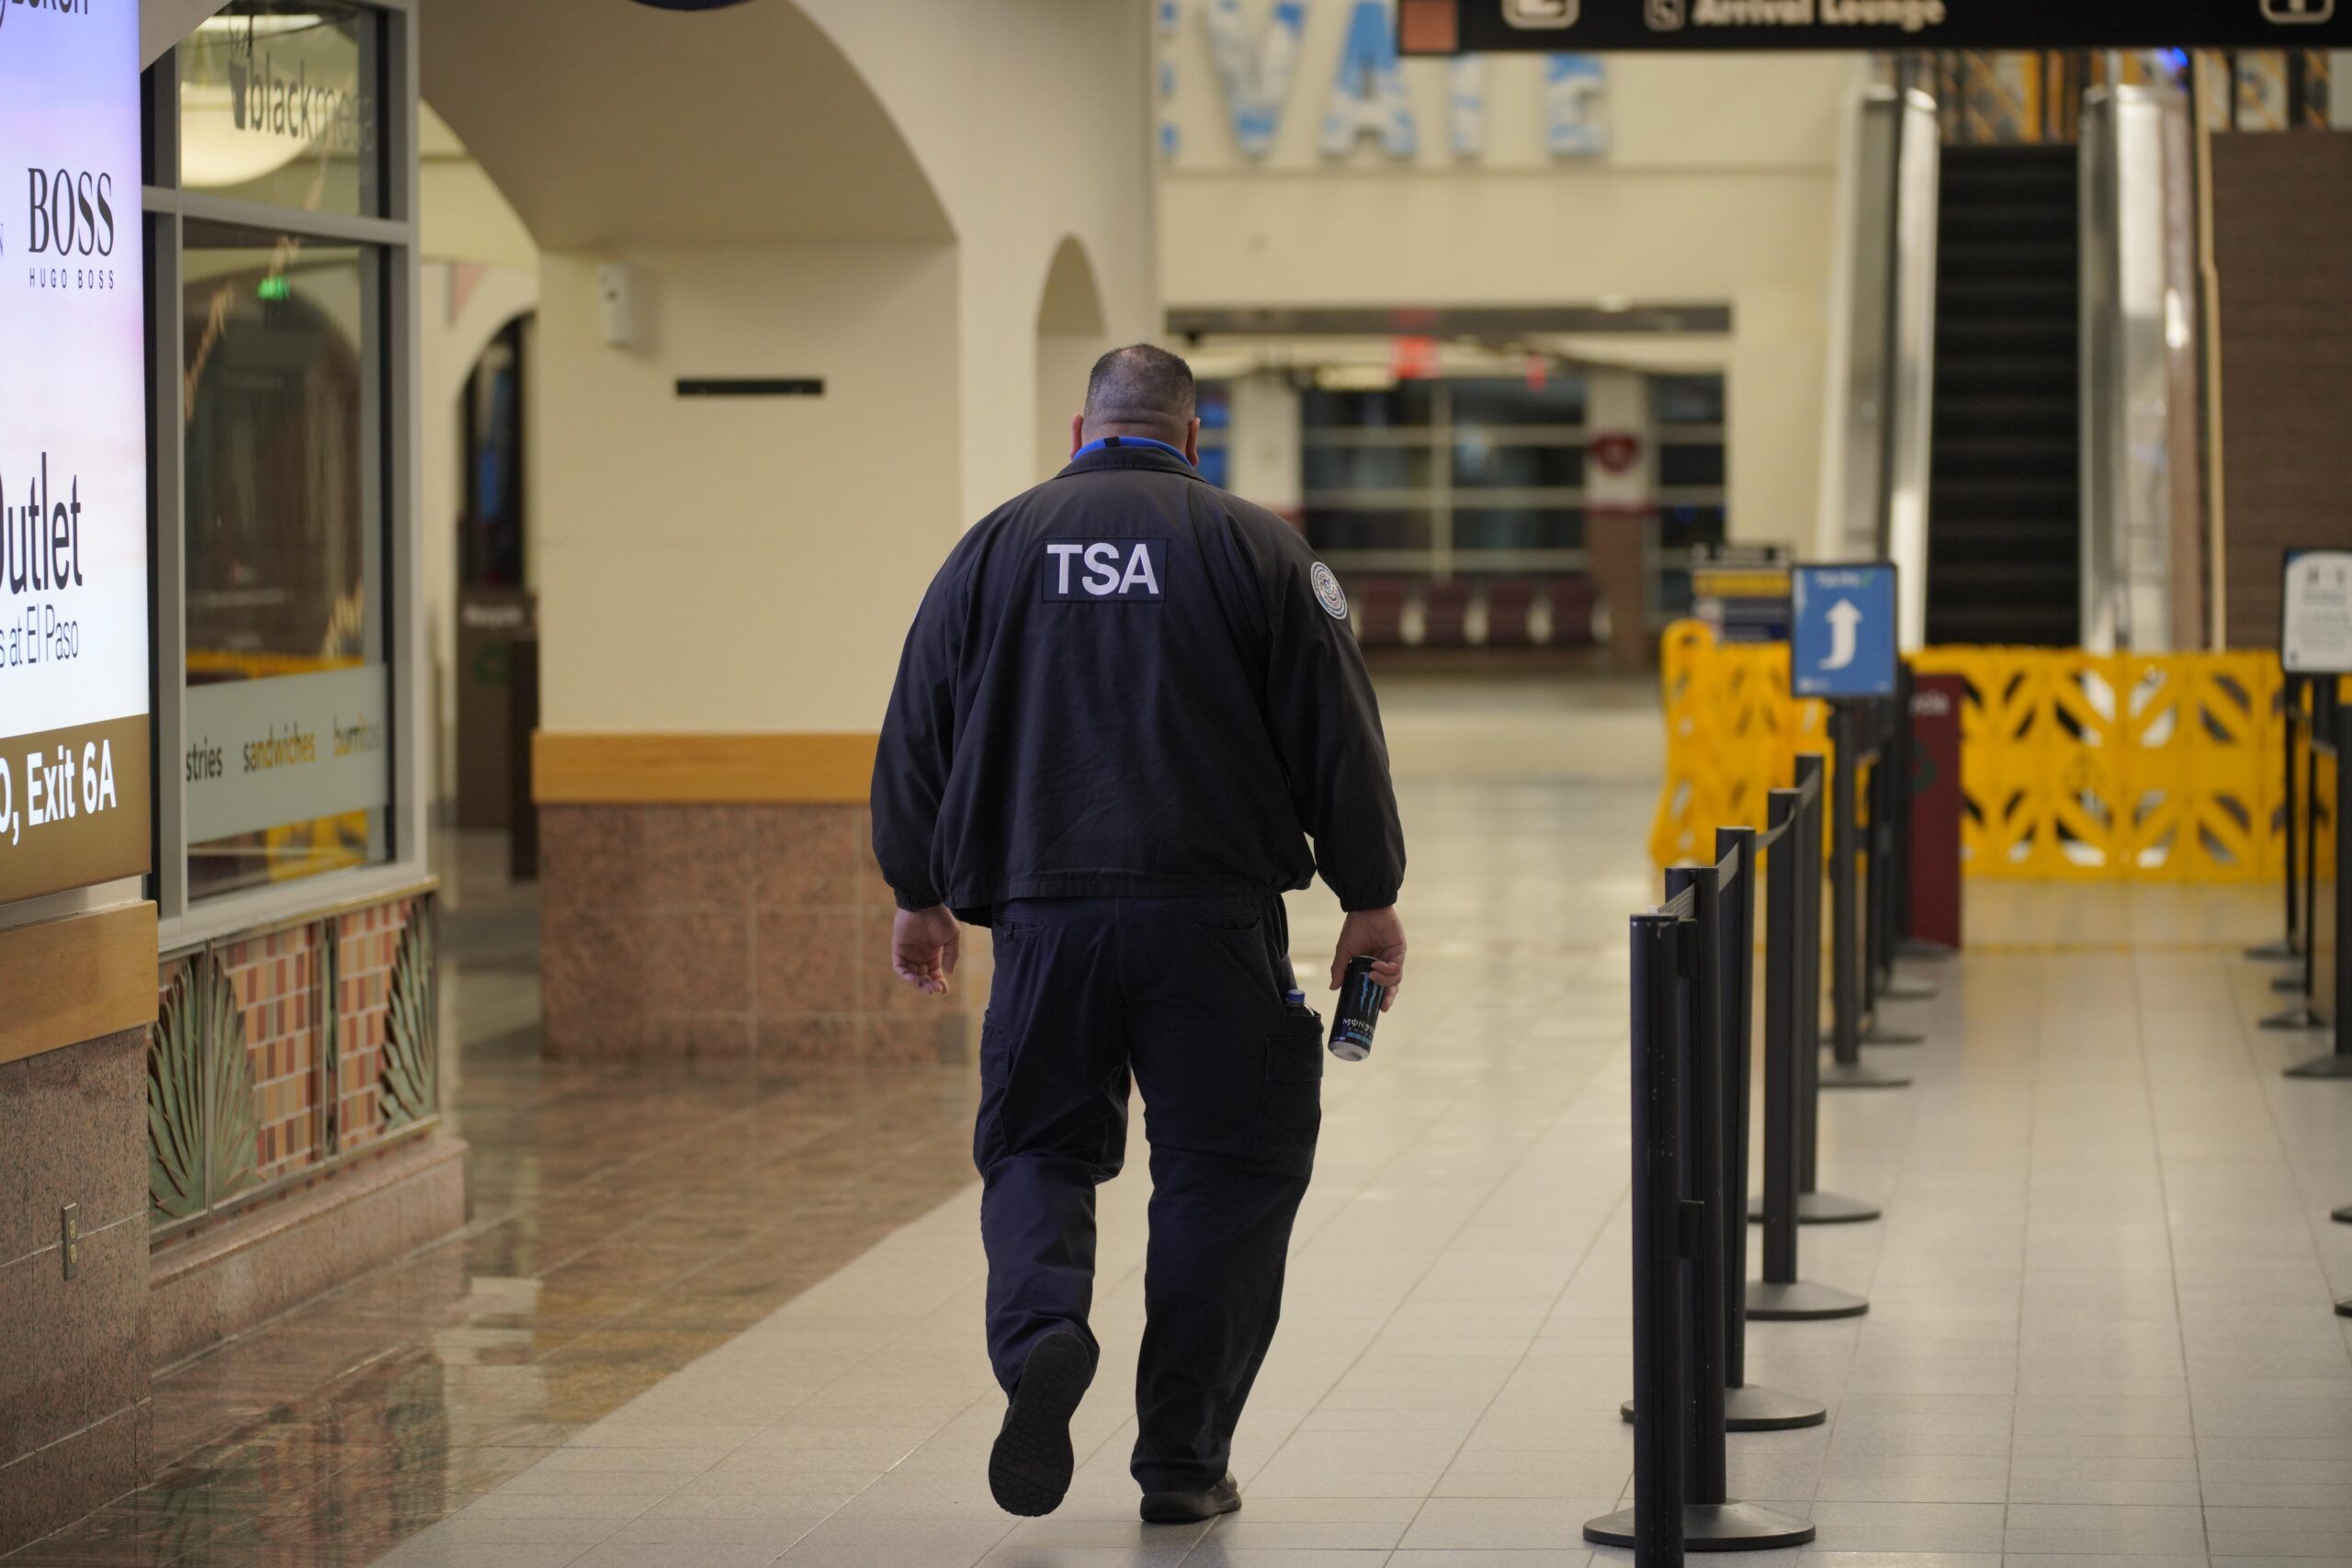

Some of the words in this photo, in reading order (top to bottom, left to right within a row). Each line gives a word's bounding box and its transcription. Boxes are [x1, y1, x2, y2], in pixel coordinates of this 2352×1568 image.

[28, 167, 114, 256] BOSS
[29, 267, 67, 288] HUGO
[78, 268, 114, 289] BOSS
[1046, 542, 1159, 596] TSA
[9, 615, 23, 667] at
[27, 603, 40, 663] El
[45, 604, 79, 661] Paso
[27, 744, 76, 827] Exit
[82, 739, 117, 815] 6A
[186, 735, 222, 783] stries
[243, 719, 317, 773] sandwiches
